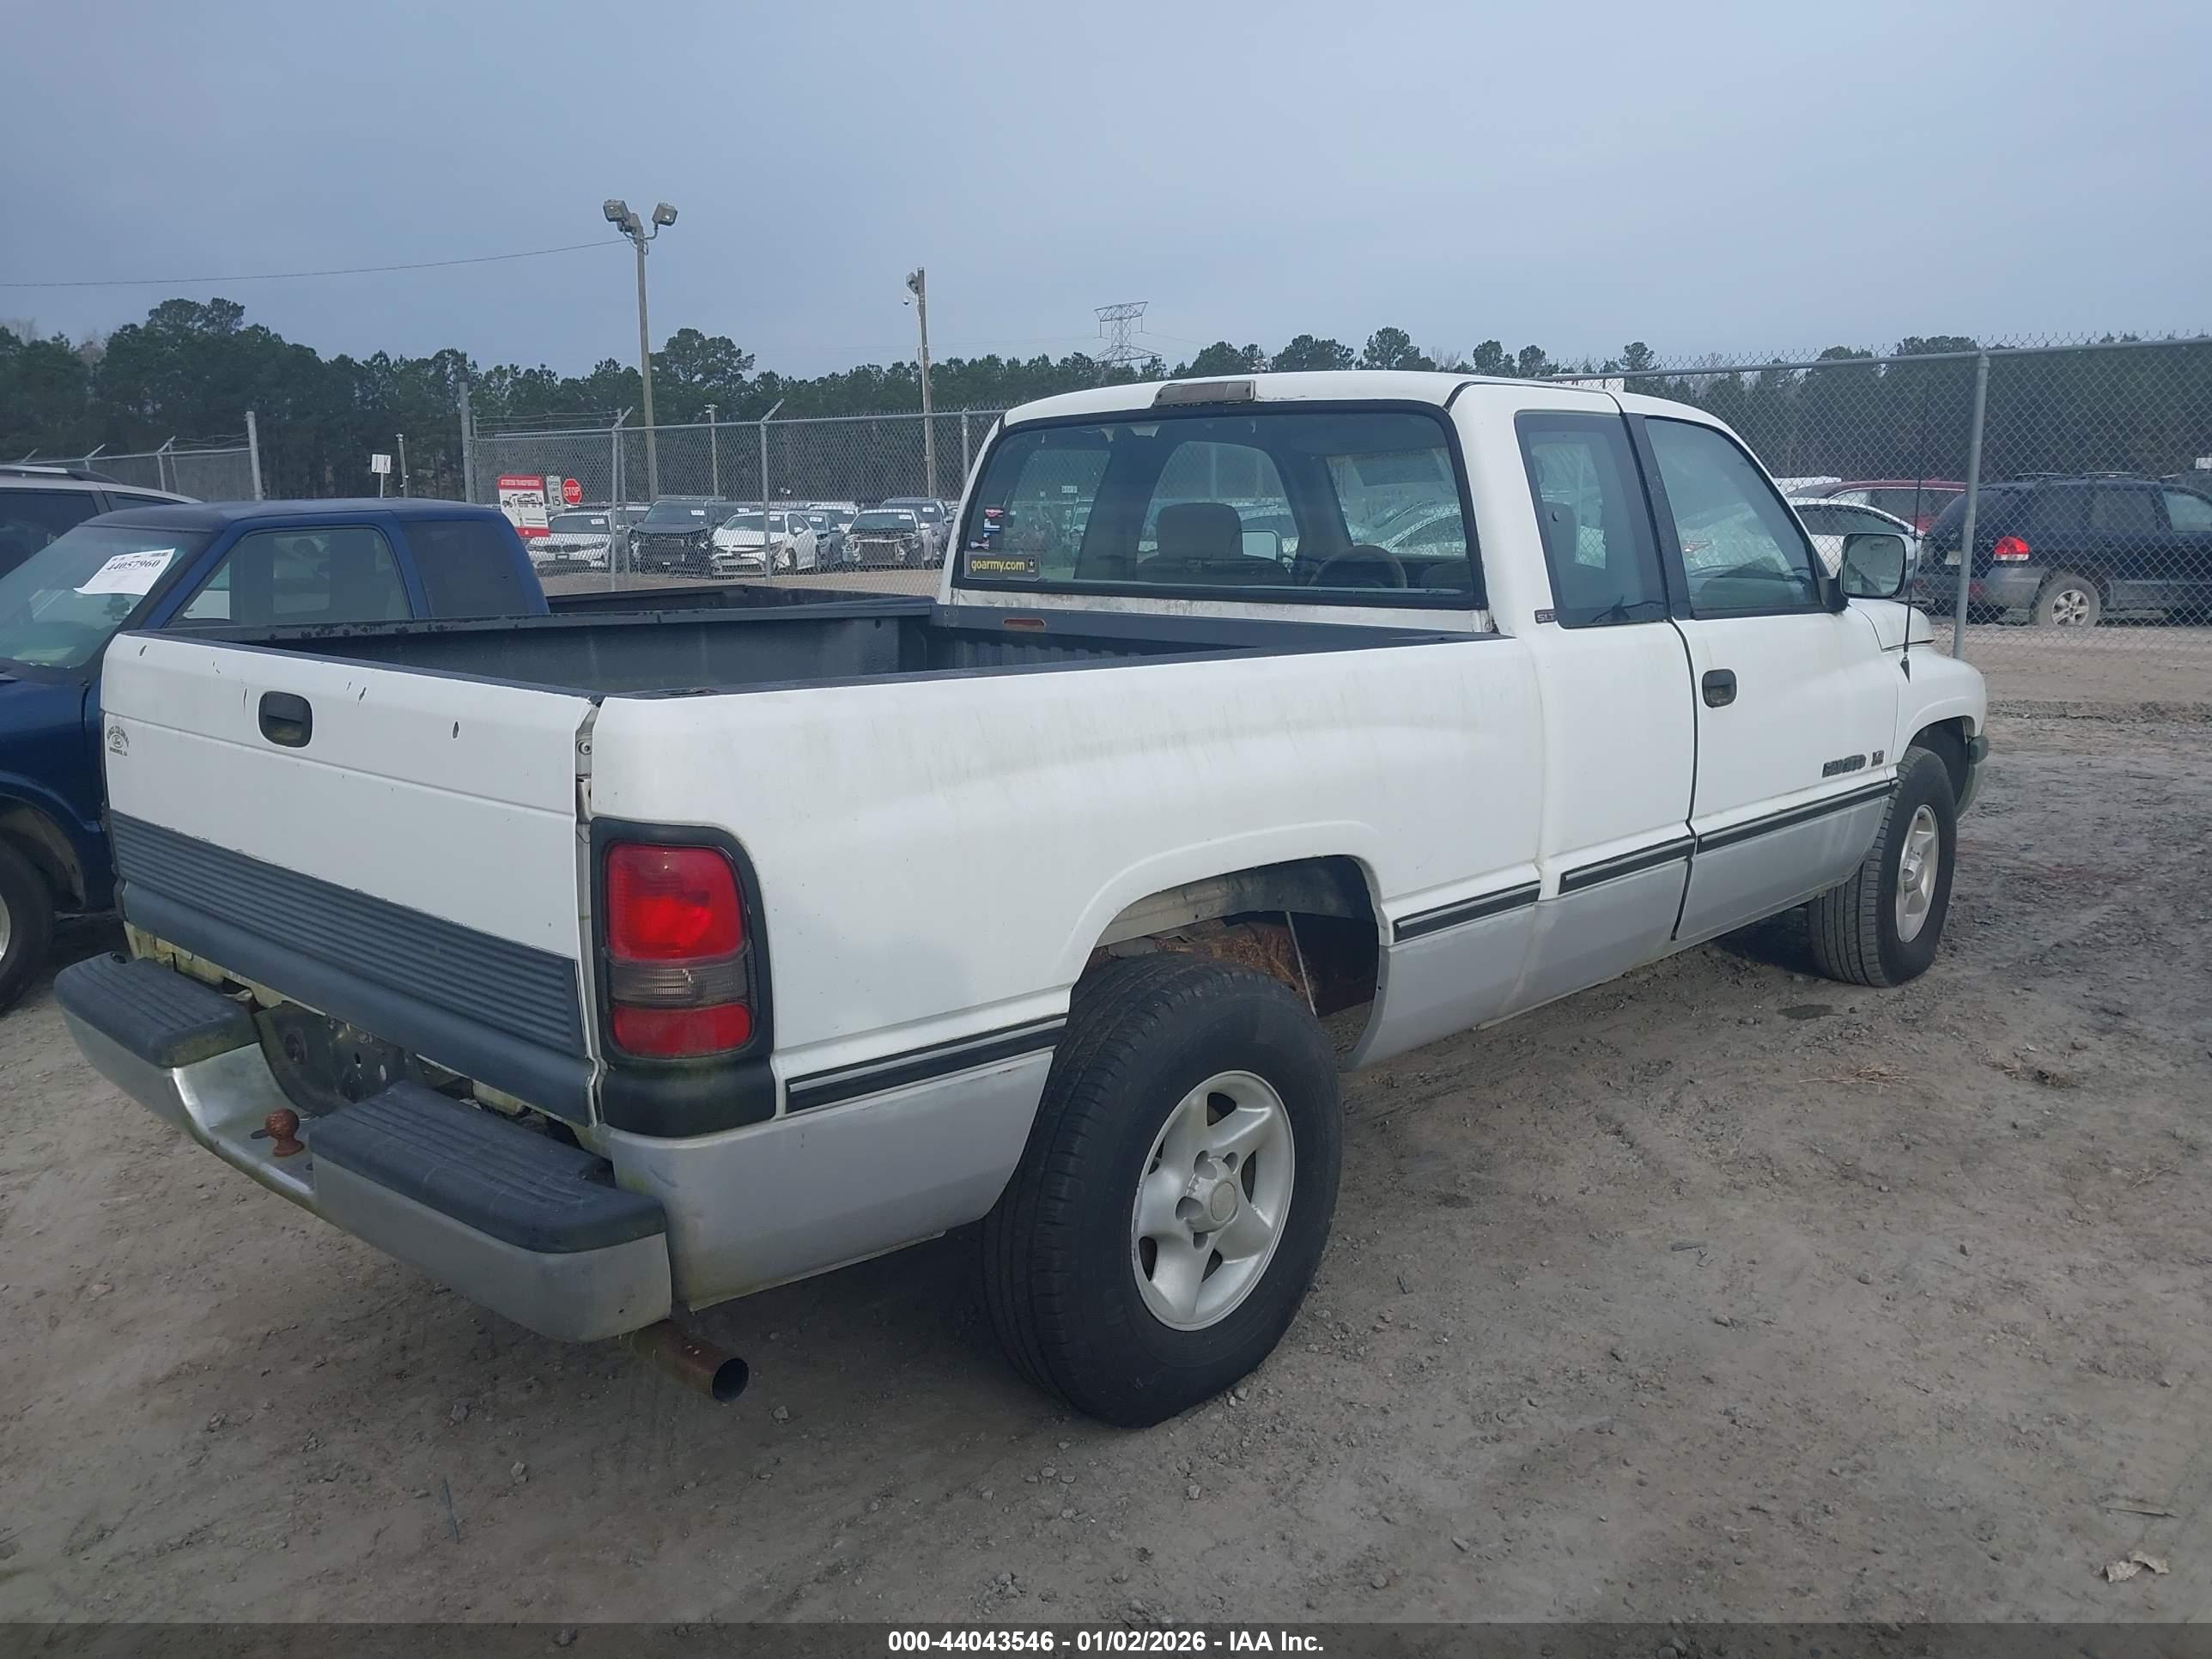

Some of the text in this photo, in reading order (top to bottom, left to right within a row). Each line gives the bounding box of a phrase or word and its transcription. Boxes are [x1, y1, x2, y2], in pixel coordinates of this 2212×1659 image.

[383, 456, 390, 472] K
[563, 487, 580, 496] STOP
[551, 495, 561, 507] 15
[971, 560, 1025, 573] goarmy.com
